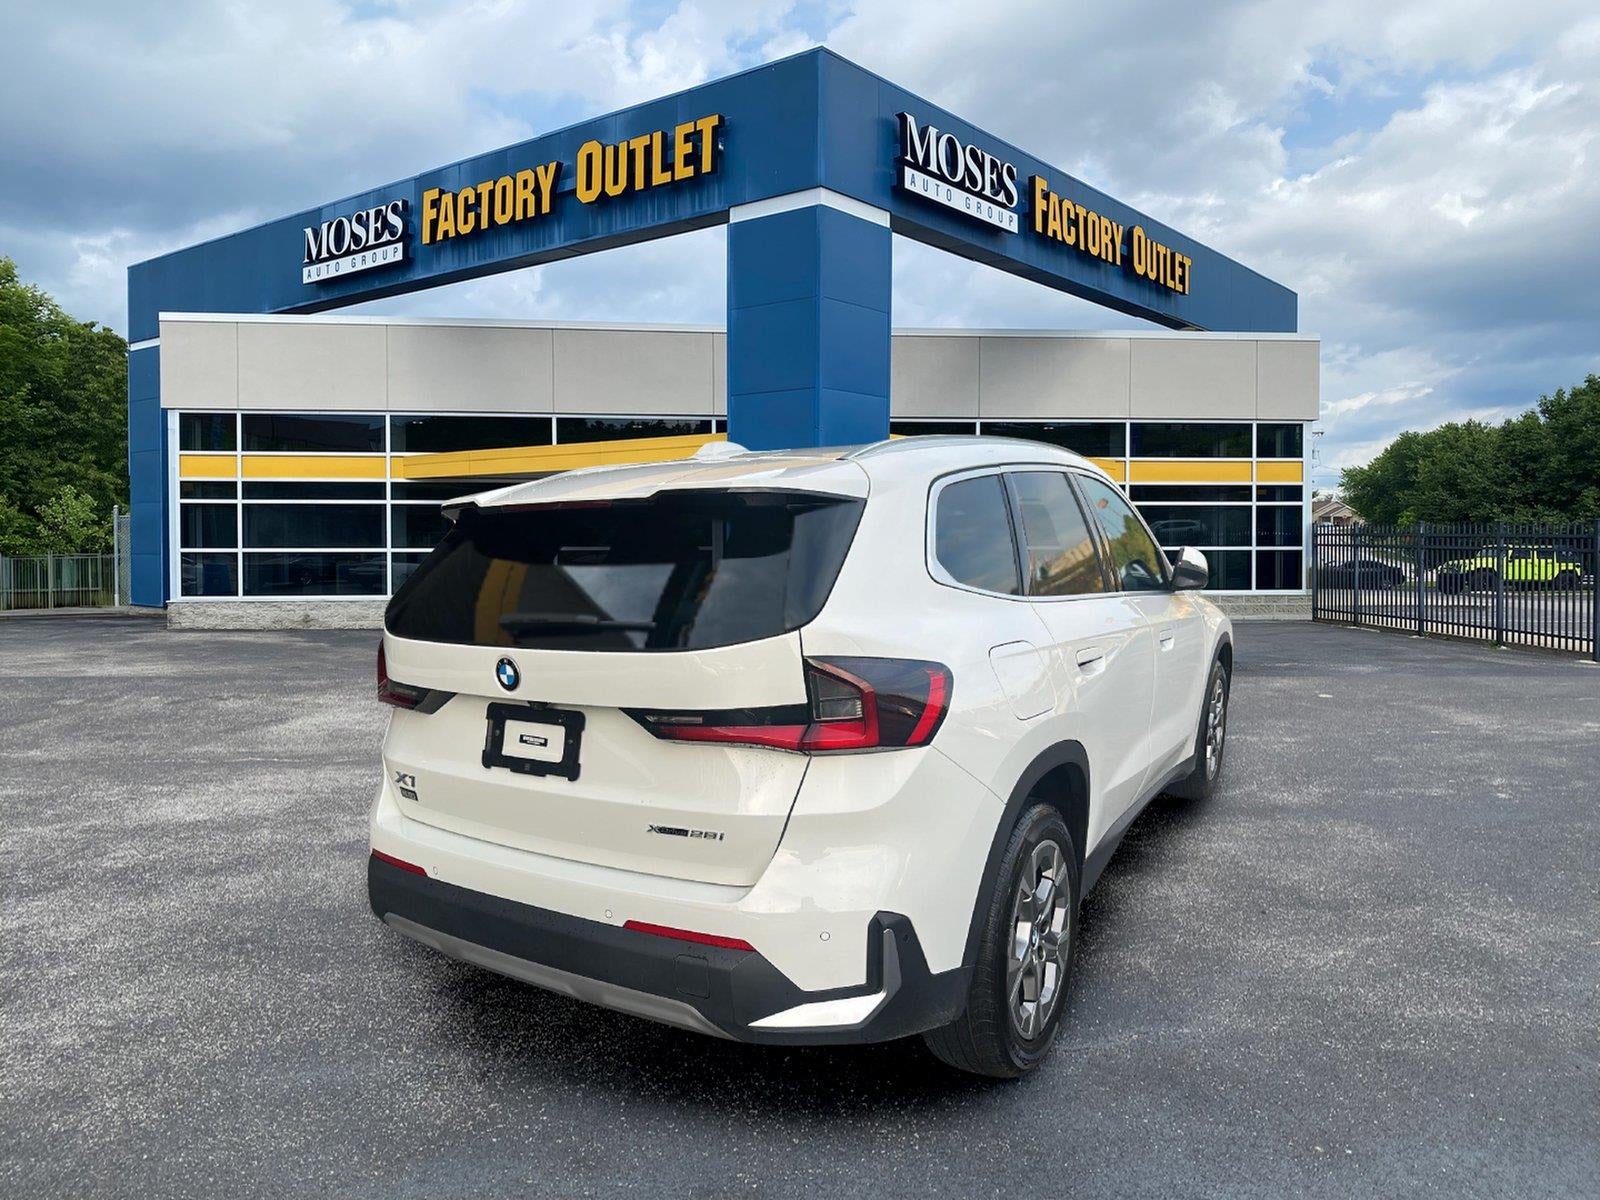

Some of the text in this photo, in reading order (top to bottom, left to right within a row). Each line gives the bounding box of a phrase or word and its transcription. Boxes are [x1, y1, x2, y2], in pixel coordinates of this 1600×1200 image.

[422, 114, 720, 245] FACTORY OUTLET
[903, 112, 1019, 208] MOSES
[303, 200, 404, 263] MOSES
[910, 173, 1014, 227] AUTO GROUP
[307, 246, 399, 280] AUTO GROUP
[1035, 175, 1192, 295] FACTORY OUTLET
[395, 771, 415, 788] X1
